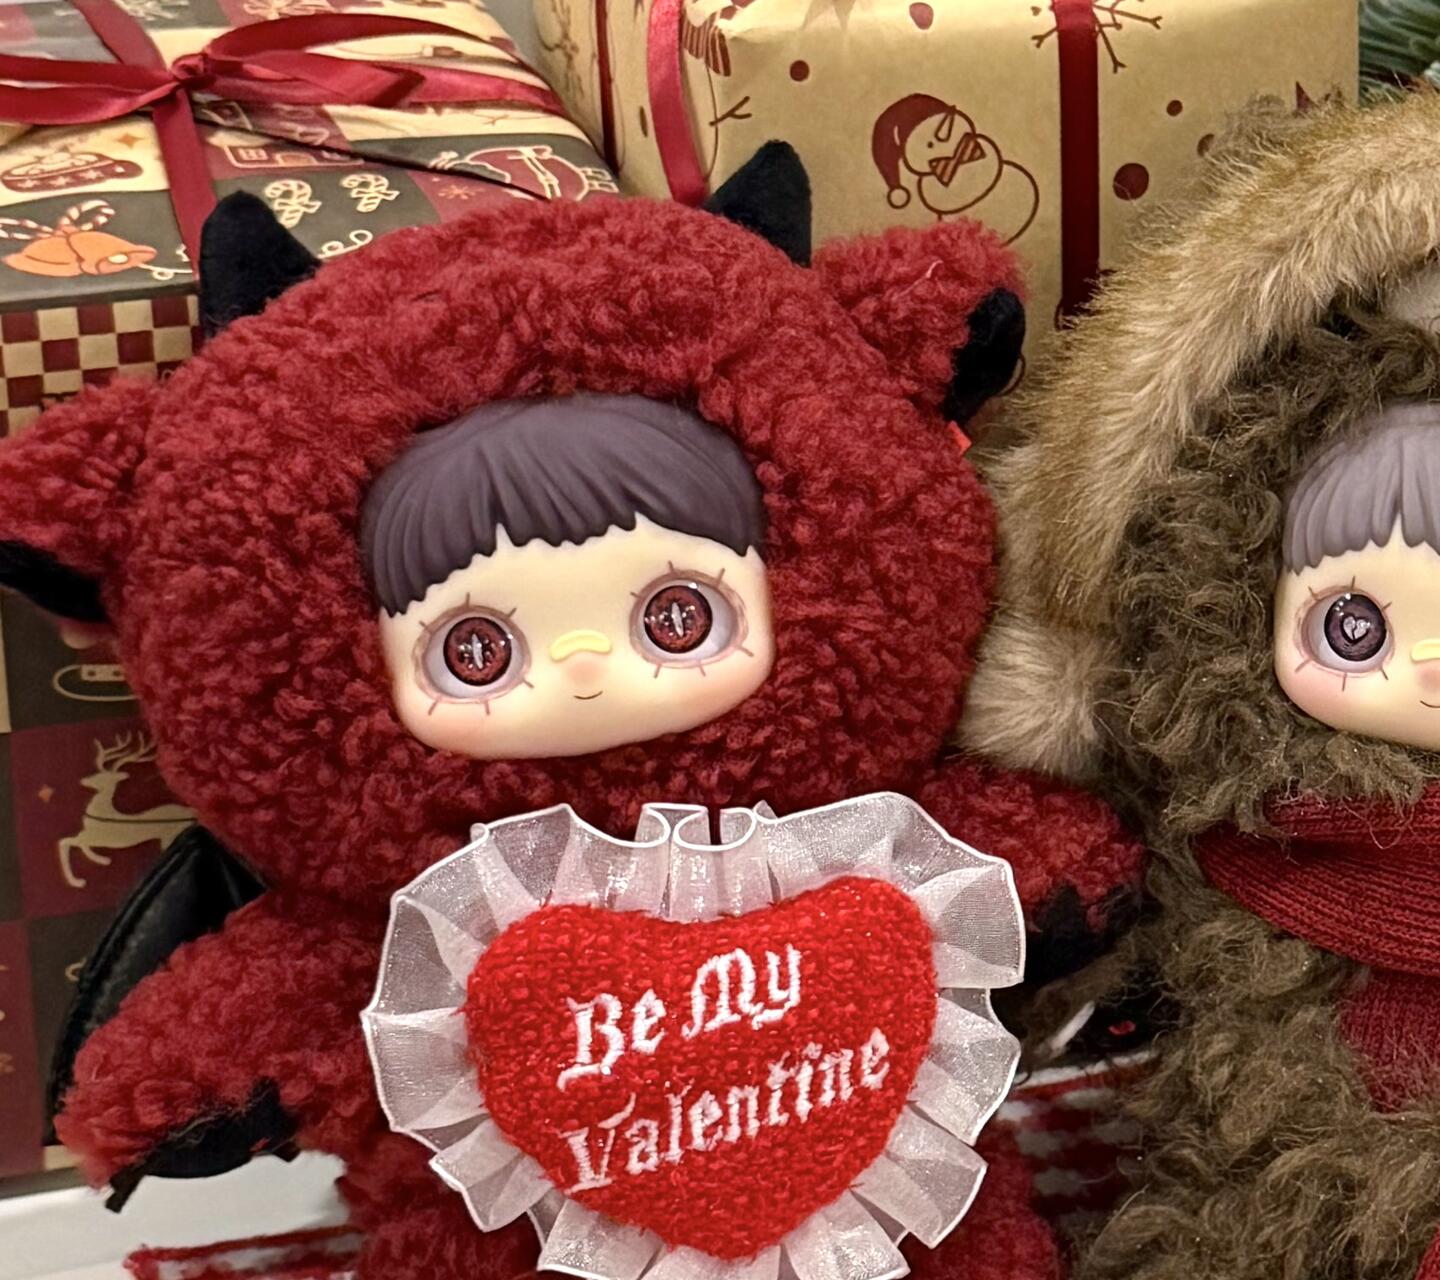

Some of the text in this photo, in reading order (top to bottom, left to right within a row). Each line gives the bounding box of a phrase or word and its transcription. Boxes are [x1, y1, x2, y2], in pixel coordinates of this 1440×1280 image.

[557, 942, 803, 1092] Be My
[558, 1026, 891, 1195] Valentine
